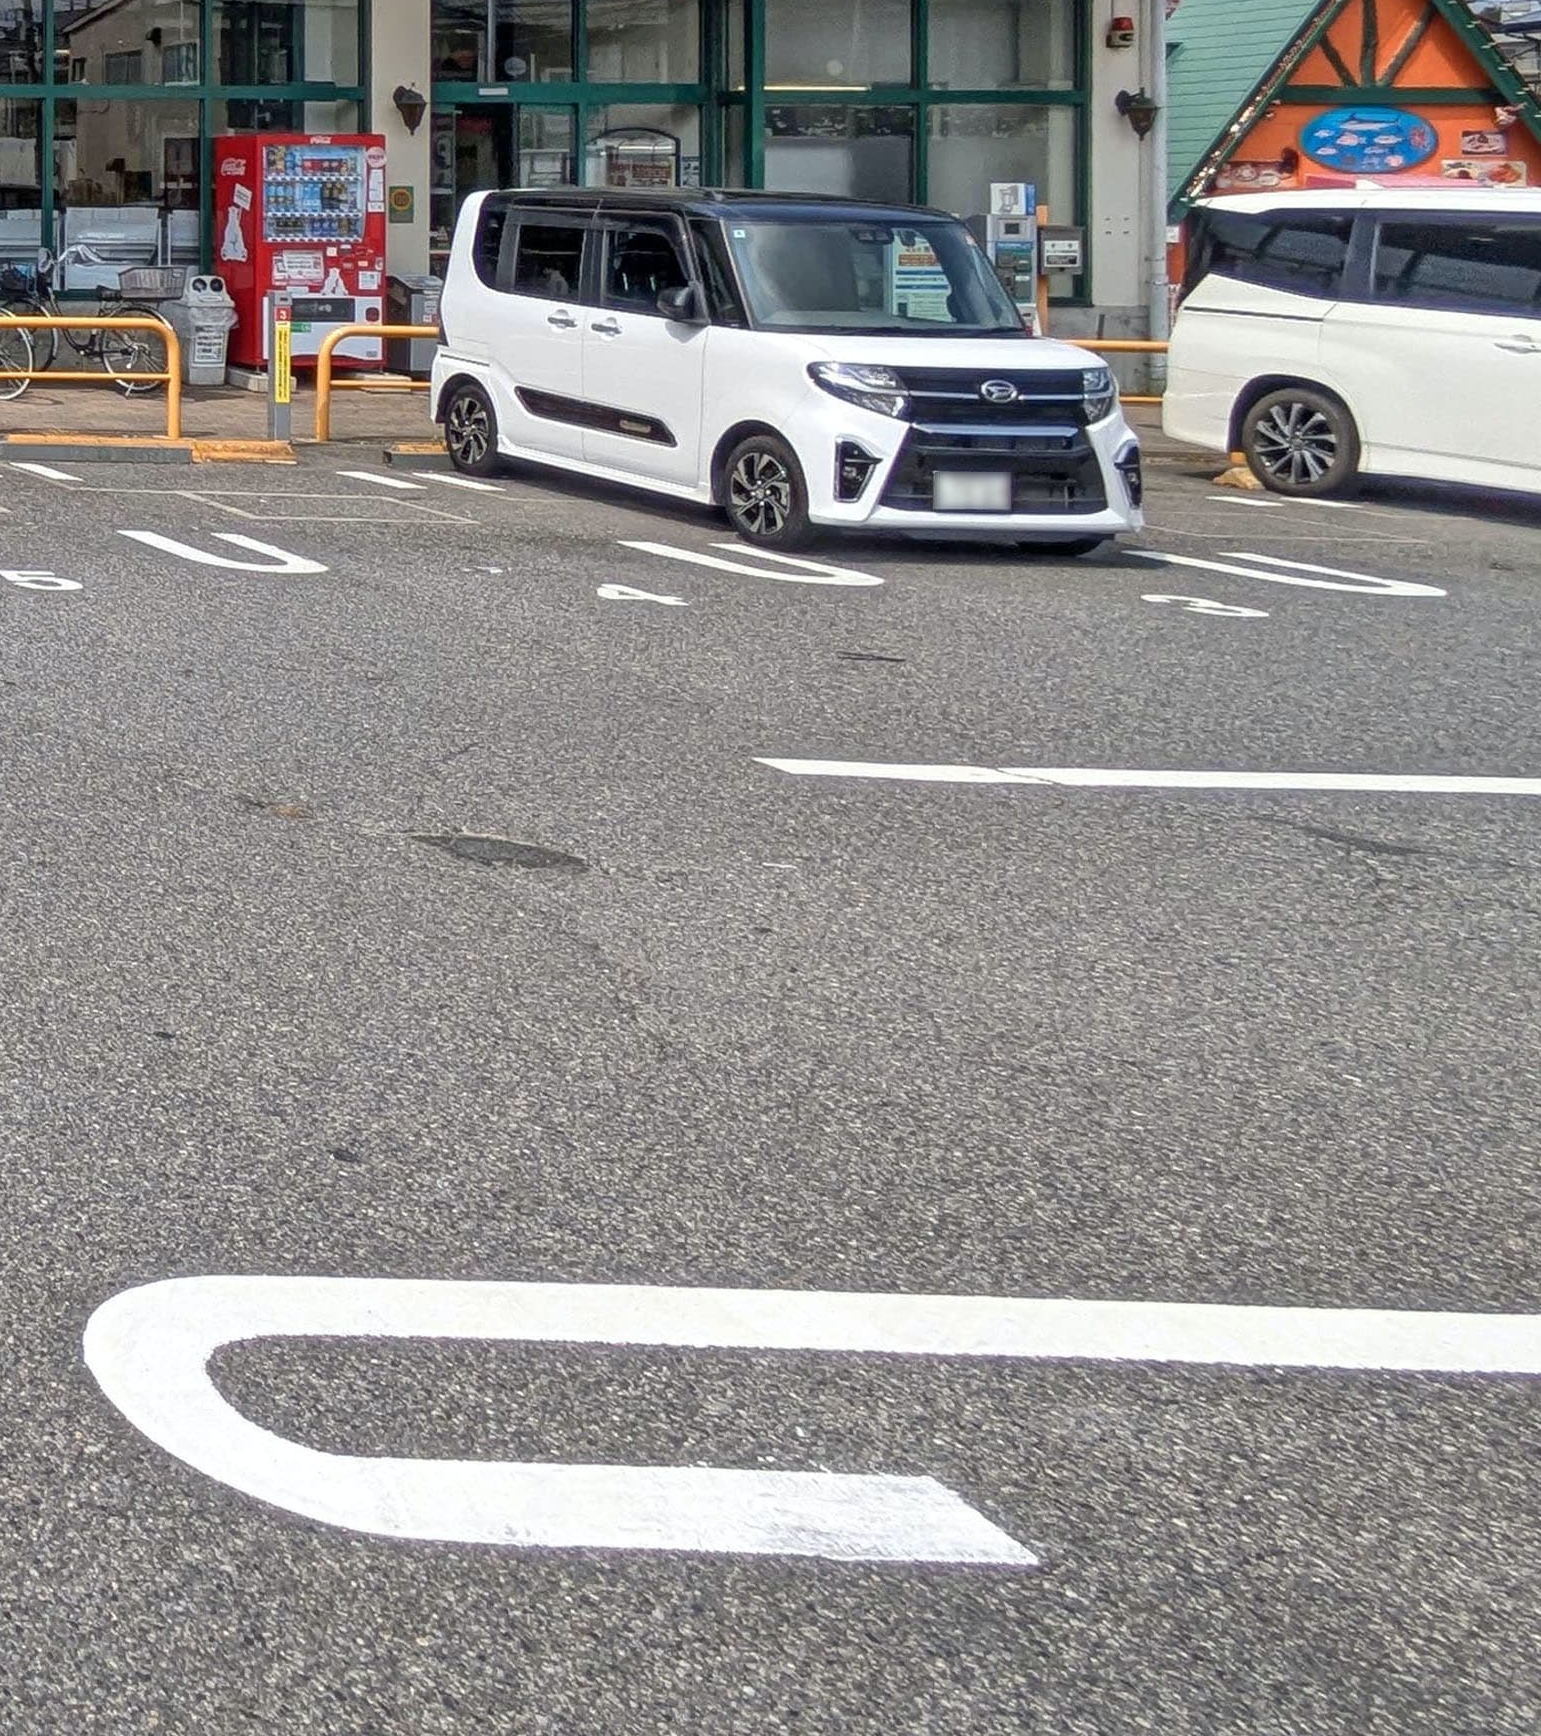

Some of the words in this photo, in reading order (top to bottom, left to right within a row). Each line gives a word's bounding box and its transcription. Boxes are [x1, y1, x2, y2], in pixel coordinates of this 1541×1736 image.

[279, 309, 287, 320] 3
[596, 583, 690, 606] 4
[1140, 594, 1270, 617] 3
